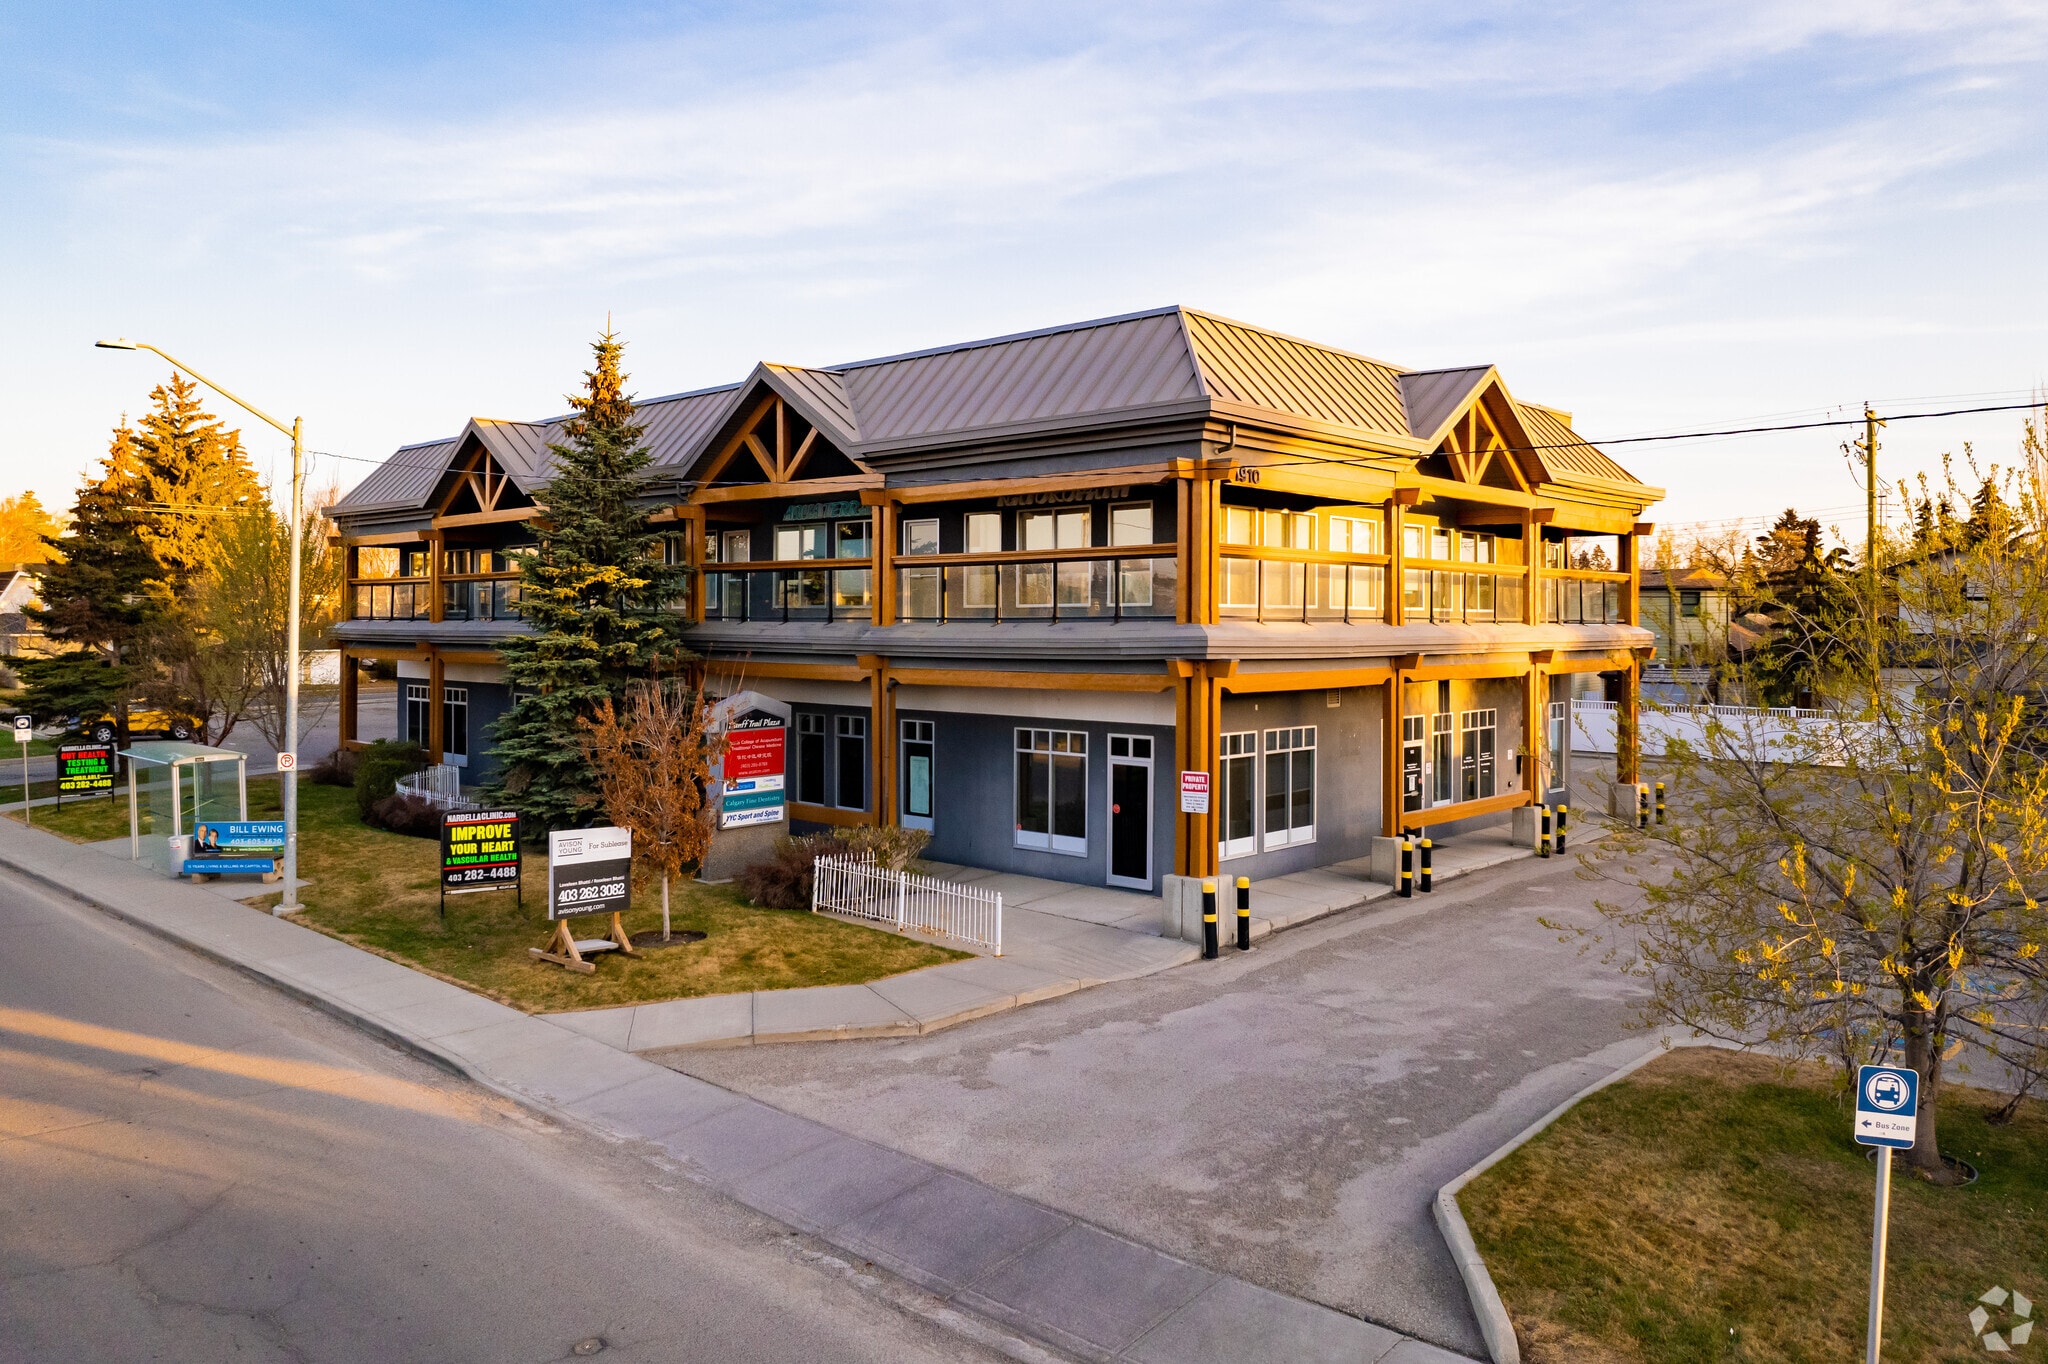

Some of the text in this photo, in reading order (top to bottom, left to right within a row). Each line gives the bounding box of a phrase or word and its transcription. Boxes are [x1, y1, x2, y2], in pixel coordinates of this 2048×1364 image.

[728, 718, 780, 729] anff Trail Plaza
[61, 752, 76, 760] GUT
[67, 758, 99, 767] TESTING
[66, 765, 109, 775] TREATMENT
[1184, 775, 1205, 783] PRIVATE
[60, 779, 112, 790] 403 282-4488
[1182, 783, 1207, 791] PROPERTY
[758, 795, 780, 803] Dentistry
[726, 814, 737, 822] YYC
[738, 812, 753, 821] Sport
[764, 809, 780, 818] Spine
[229, 825, 284, 834] BILL EWING
[452, 823, 512, 842] IMPROVE
[450, 840, 515, 856] YOUR HEART
[600, 841, 628, 849] Sublease
[453, 855, 489, 865] VASCULAR
[490, 853, 518, 862] HEALTH
[447, 866, 517, 882] 403 282-4488
[558, 883, 625, 902] 403 262 3082
[558, 903, 606, 915] avisonyoung.com
[1876, 1121, 1910, 1131] Bus Zone
